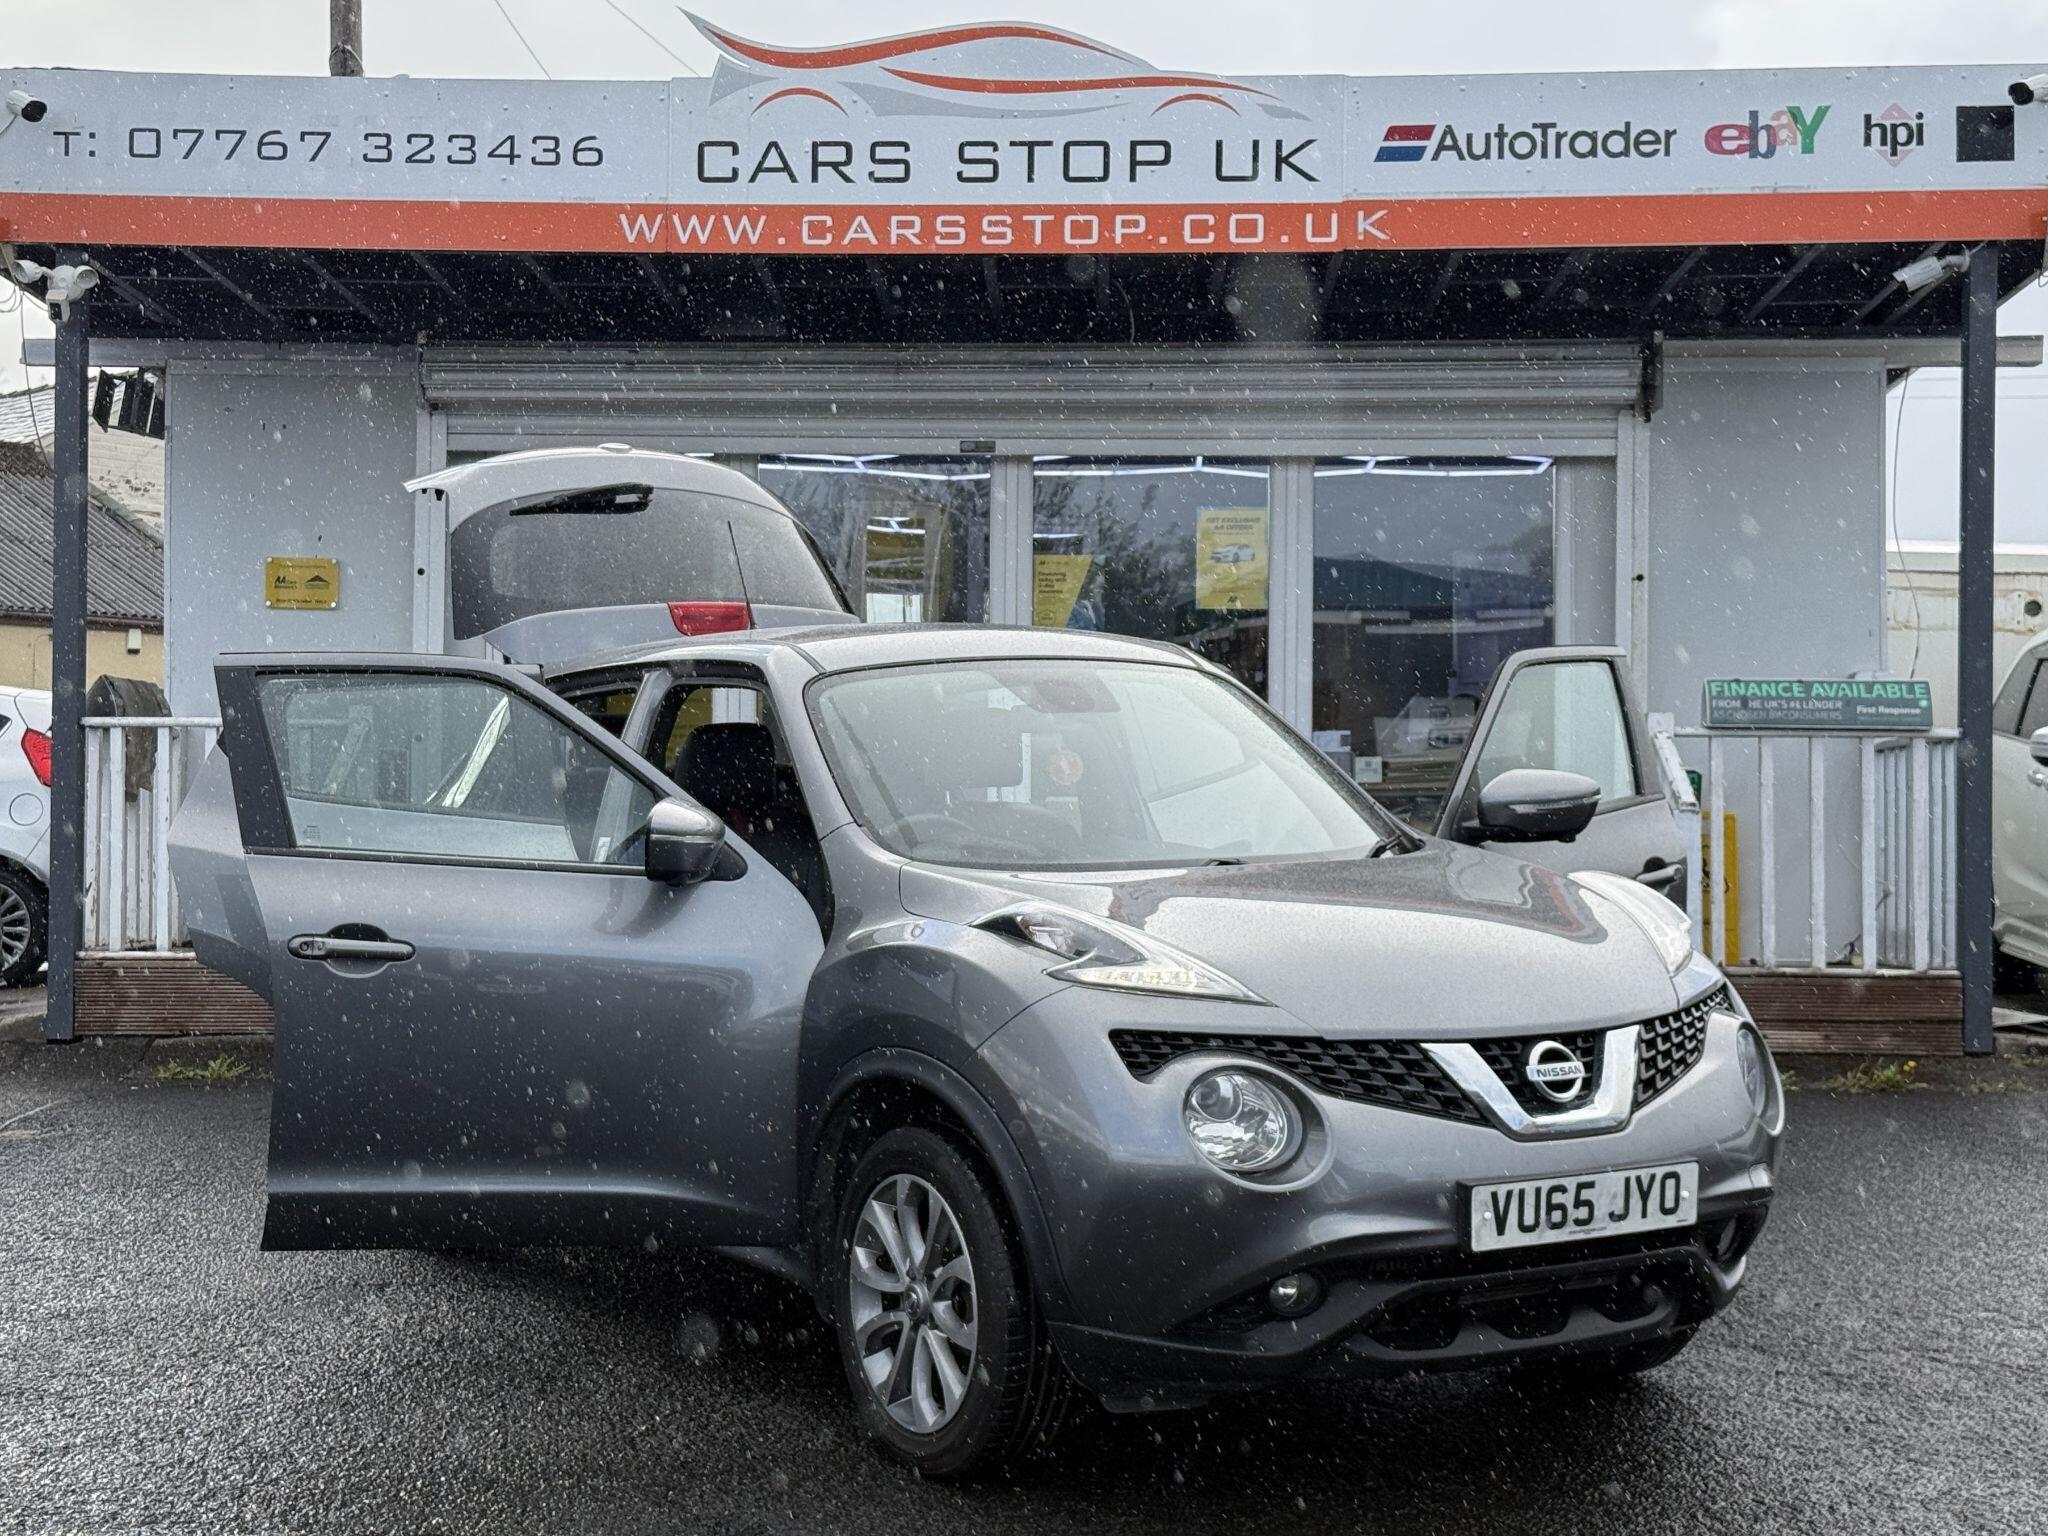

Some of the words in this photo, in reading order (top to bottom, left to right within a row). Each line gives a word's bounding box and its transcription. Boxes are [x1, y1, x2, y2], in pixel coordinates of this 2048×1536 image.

[53, 131, 97, 158] T:
[127, 128, 332, 162] 07767
[362, 132, 605, 168] 323436
[1432, 121, 1677, 161] AutoTrader
[1863, 112, 1925, 153] hpi
[697, 140, 912, 184] CARS
[956, 139, 1173, 184] STOP
[1214, 138, 1322, 183] UK
[619, 208, 1389, 247] WWW.CARSSTOP.CO.UK
[1710, 682, 1806, 698] FINANCE
[1810, 682, 1928, 699] AVAILABLE
[1712, 699, 1740, 709] FROM
[1803, 700, 1842, 710] LENDER
[1536, 1064, 1583, 1078] NISSAN
[1490, 1180, 1597, 1237] VU65
[1608, 1170, 1682, 1223] JYO
